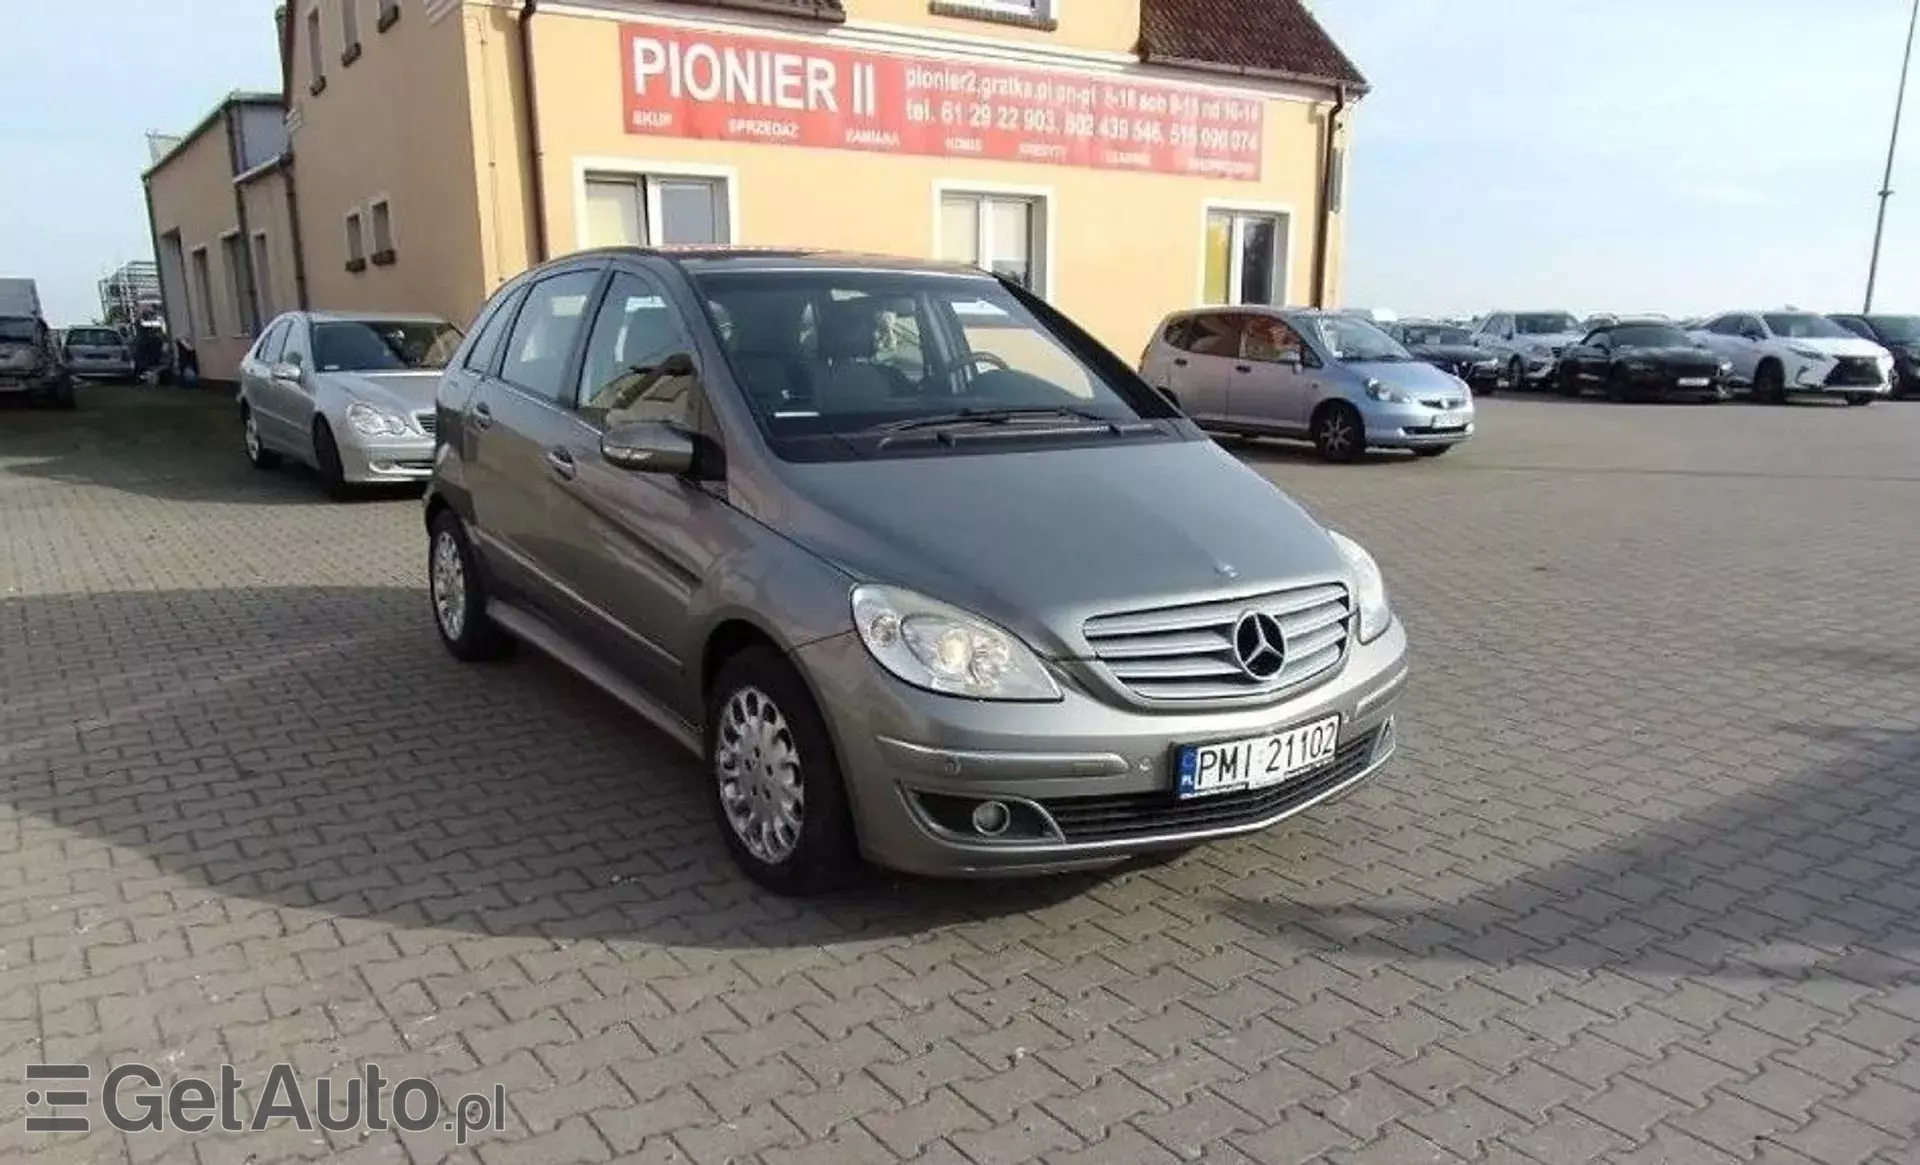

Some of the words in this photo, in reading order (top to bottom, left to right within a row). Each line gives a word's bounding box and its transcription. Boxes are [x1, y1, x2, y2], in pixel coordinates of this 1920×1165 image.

[632, 36, 839, 113] PIONIER
[853, 62, 876, 117] II
[941, 100, 963, 126] 61
[969, 103, 991, 129] 29
[997, 105, 1019, 131] 22
[1199, 743, 1252, 786] PMI
[1265, 721, 1336, 773] 21102
[1182, 776, 1193, 786] PL
